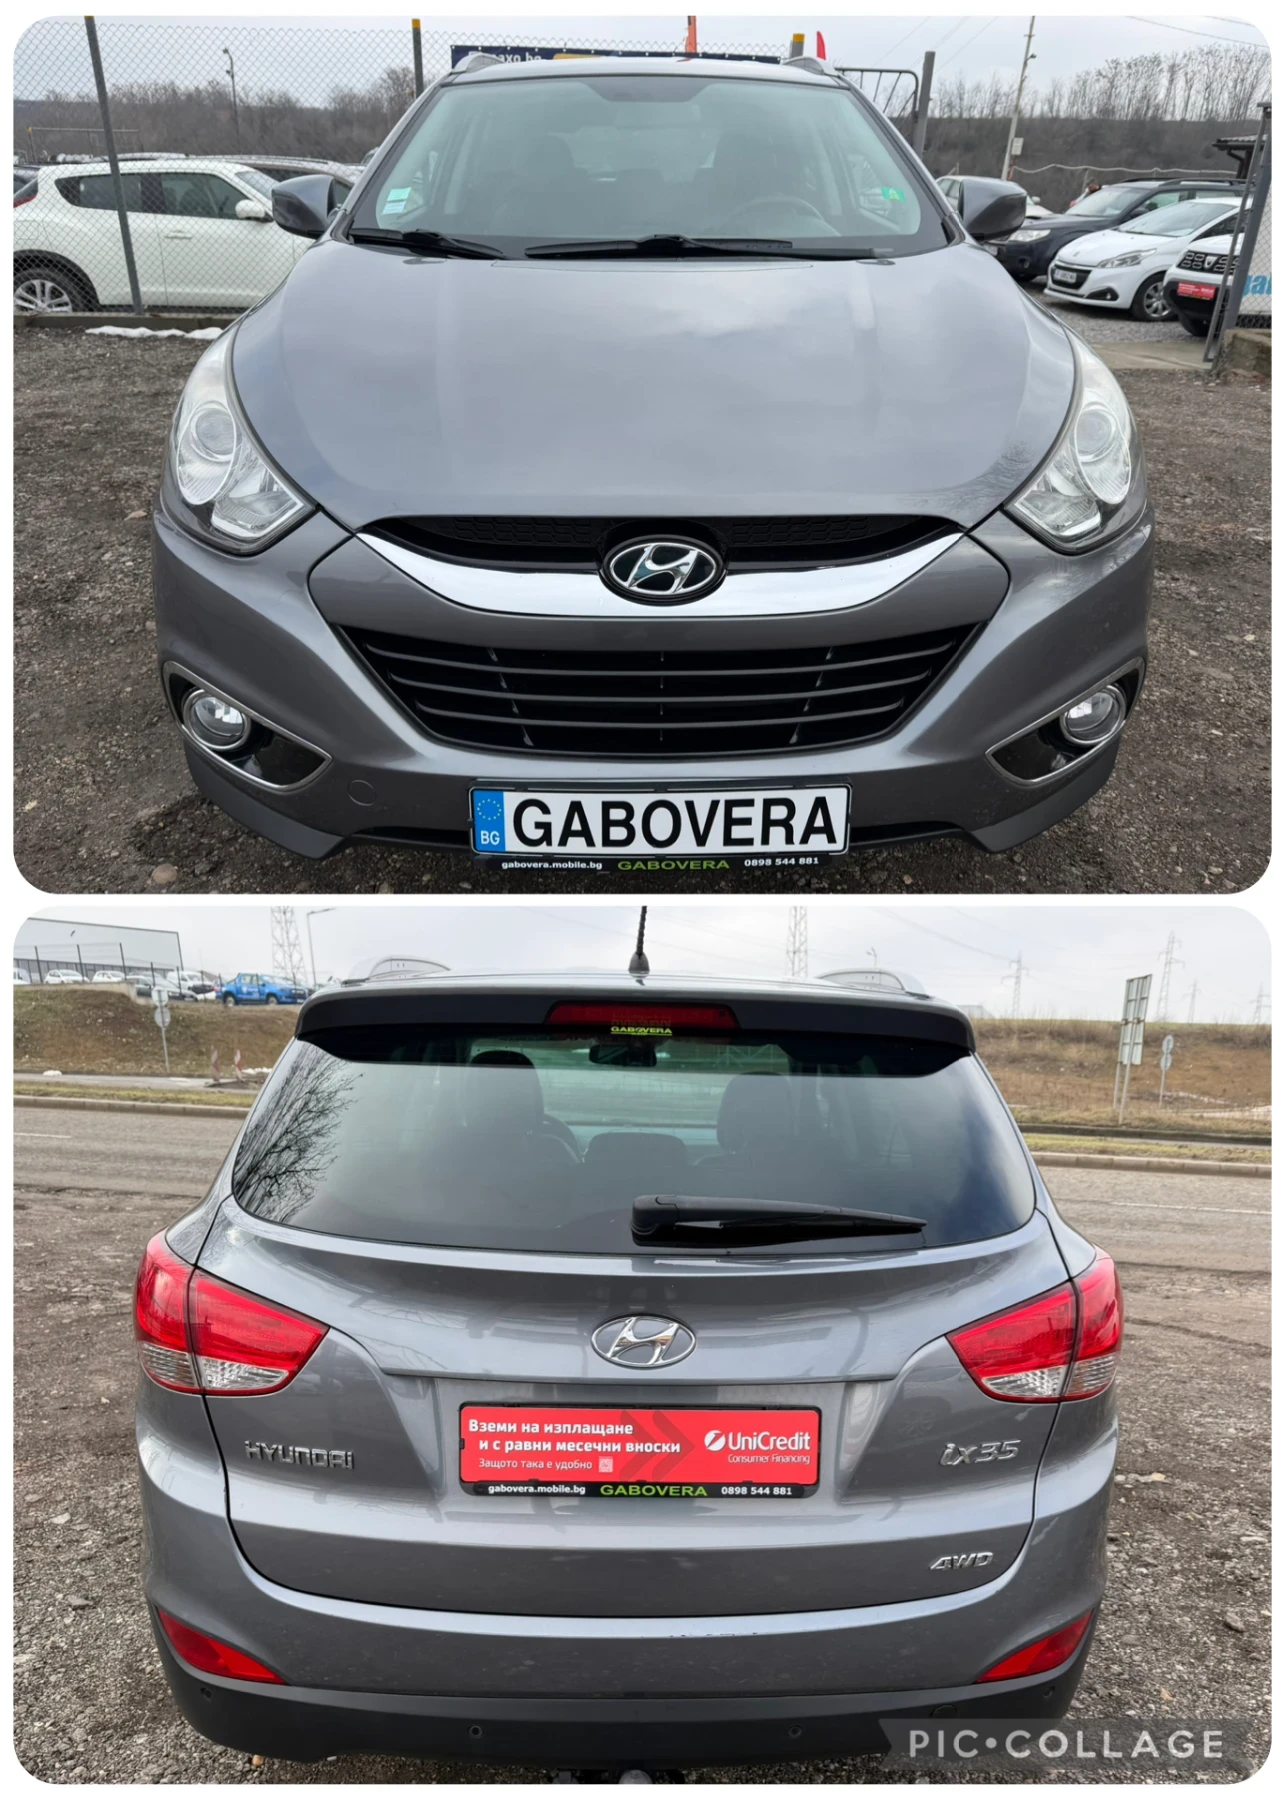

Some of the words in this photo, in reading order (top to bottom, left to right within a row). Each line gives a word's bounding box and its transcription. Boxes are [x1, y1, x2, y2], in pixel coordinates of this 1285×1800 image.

[512, 796, 838, 848] GABOVERA
[480, 830, 500, 846] BG
[501, 861, 602, 870] gabovera.mobile.bg
[617, 860, 730, 871] GABOVERA
[744, 858, 772, 867] 0898
[775, 857, 796, 866] 544
[799, 856, 819, 865] 881
[468, 1419, 518, 1433] Вземи
[521, 1423, 540, 1433] на
[544, 1423, 634, 1435] изплащане
[479, 1440, 489, 1450] и
[492, 1440, 501, 1450] с
[505, 1440, 552, 1453] равни
[556, 1442, 621, 1452] месечни
[625, 1442, 681, 1453] вноски
[728, 1431, 811, 1451] UniCredit
[244, 1440, 354, 1469] HYUNDAI
[728, 1453, 770, 1464] Consumer
[772, 1454, 811, 1465] Financing
[939, 1439, 1021, 1466] ix35
[479, 1457, 518, 1469] Защото
[521, 1459, 544, 1469] така
[546, 1461, 553, 1469] е
[555, 1459, 593, 1470] удобно
[488, 1484, 586, 1495] gabovera.mobile.bg
[600, 1484, 708, 1497] GABOVERA
[721, 1486, 748, 1495] 0898
[750, 1486, 771, 1495] 544
[773, 1486, 792, 1495] 881
[929, 1551, 994, 1570] 4WD
